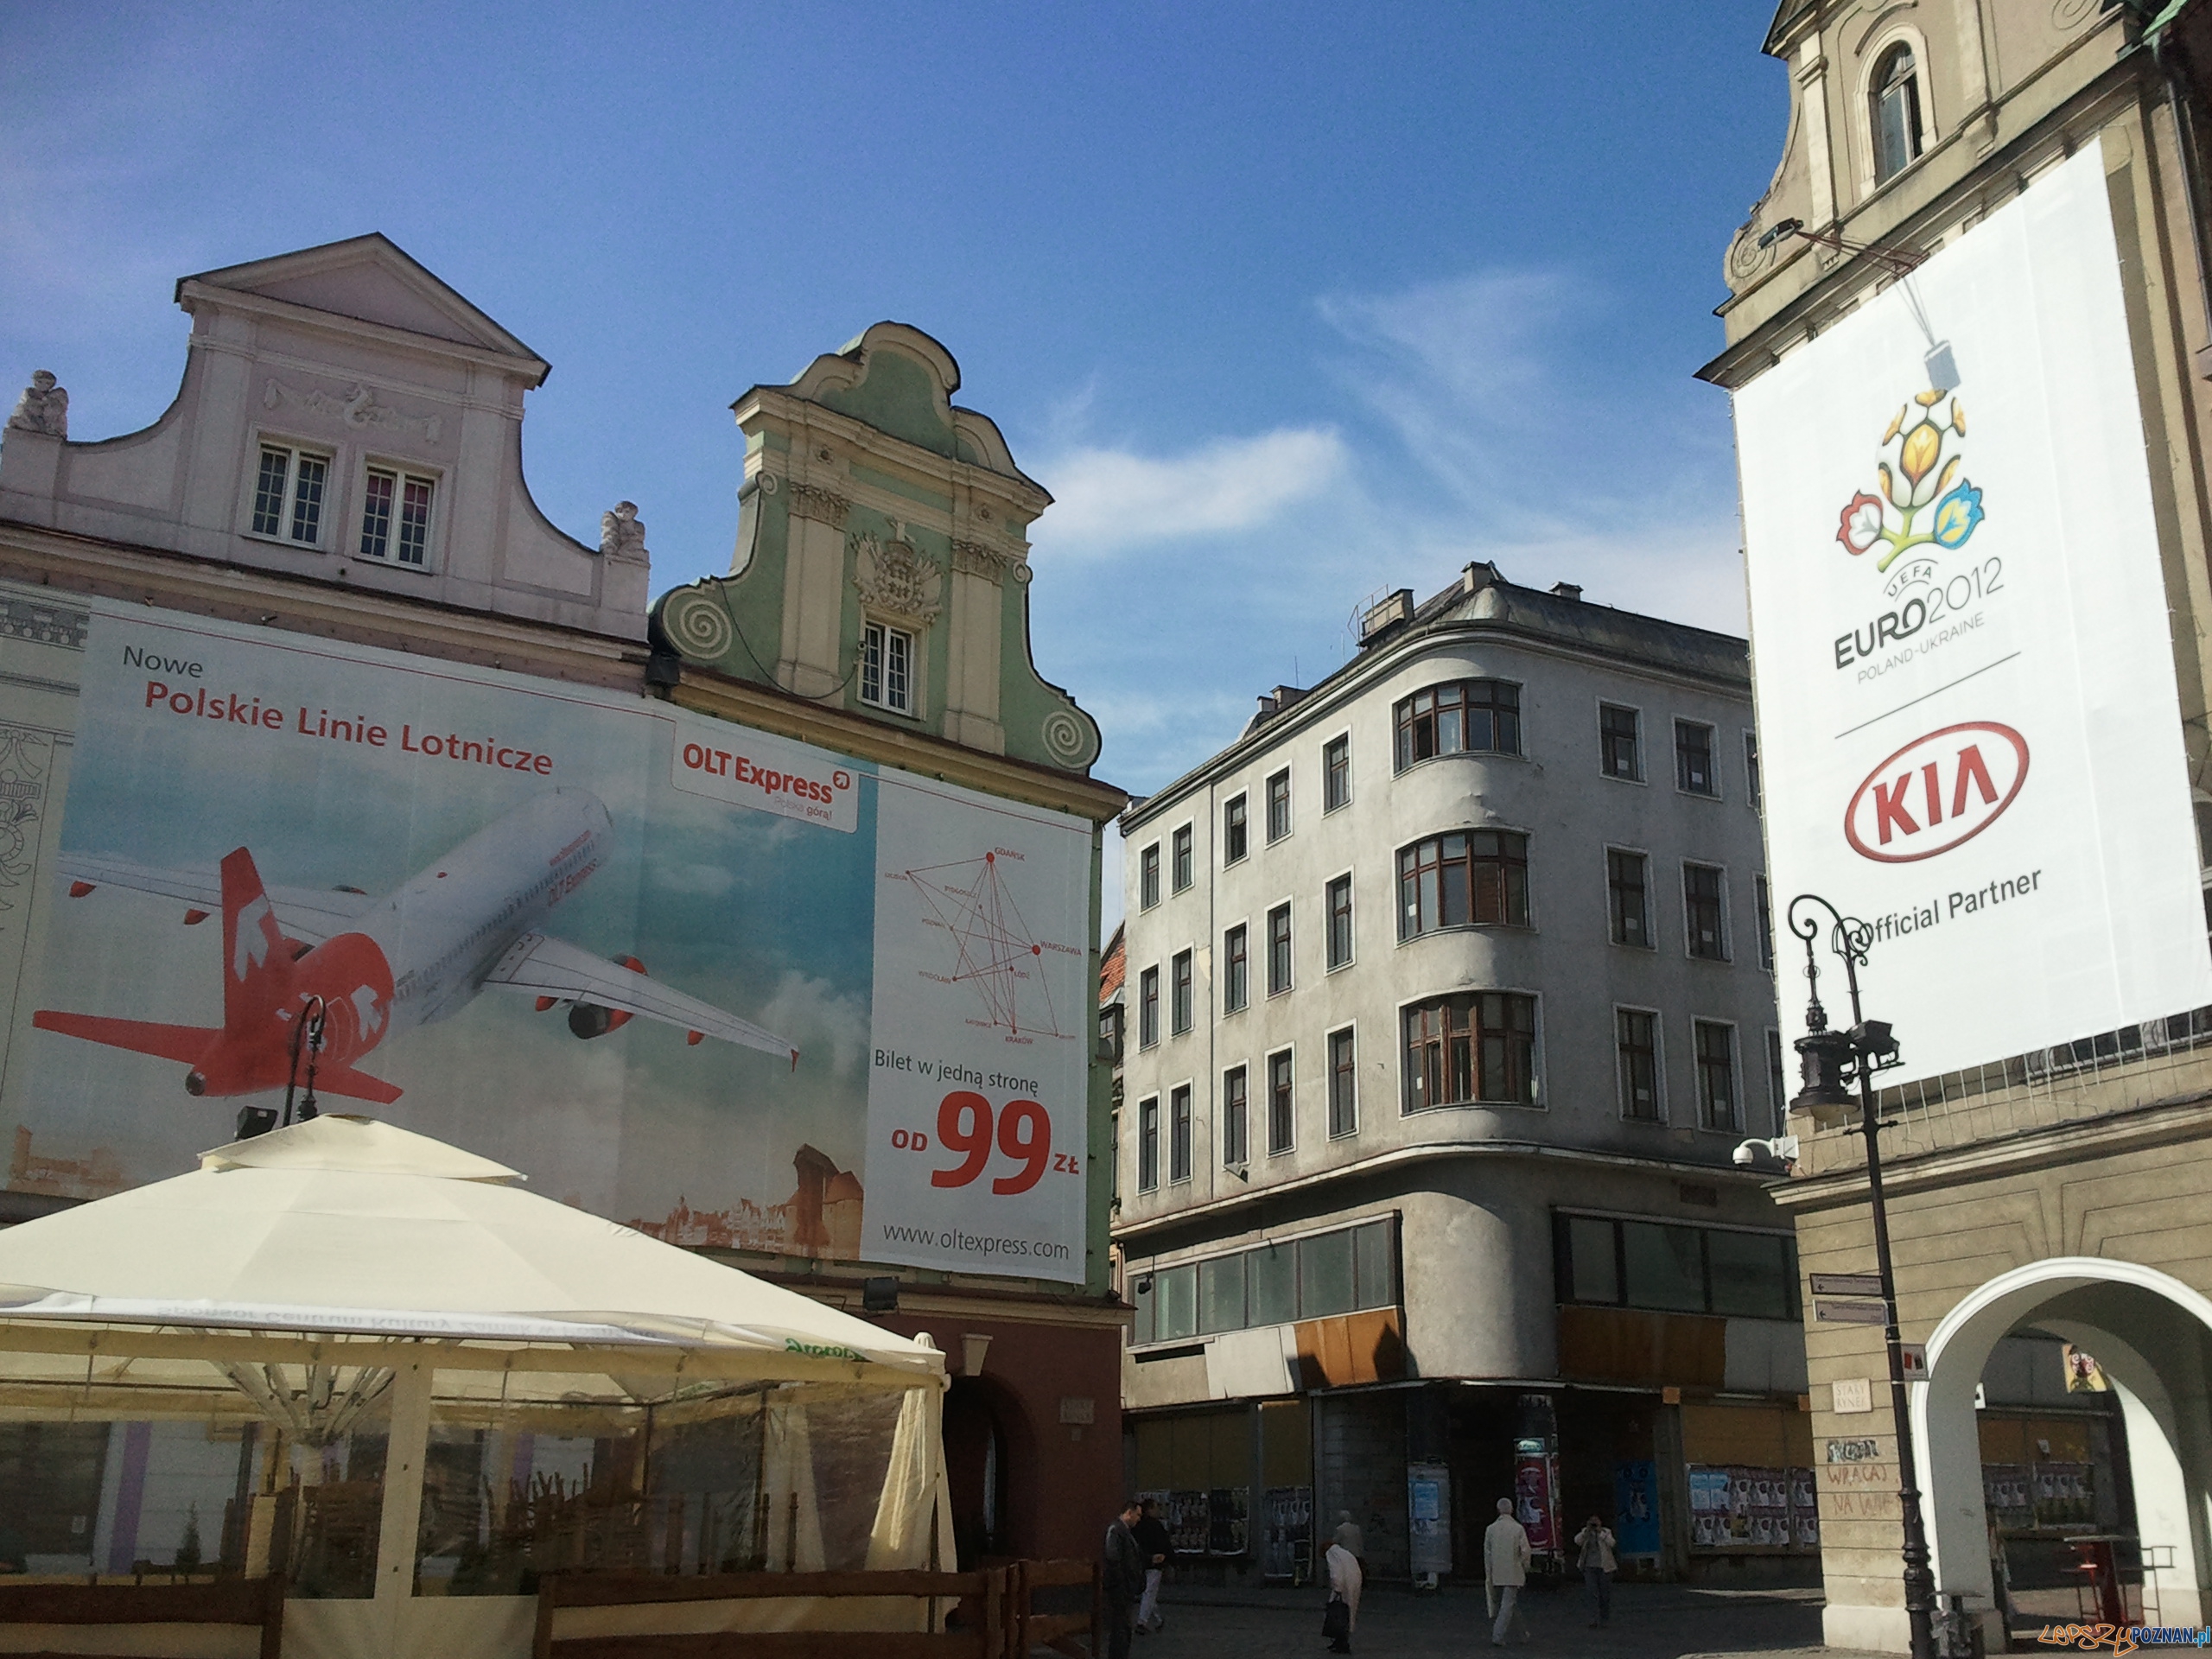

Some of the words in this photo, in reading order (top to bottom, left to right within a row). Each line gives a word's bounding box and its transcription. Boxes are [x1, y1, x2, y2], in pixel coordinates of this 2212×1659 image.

[1887, 565, 1932, 598] UEFA
[124, 645, 204, 678] Nowe
[145, 681, 283, 730] Polskie
[298, 707, 388, 747] Linie
[401, 725, 554, 775] Lotnicze
[683, 743, 733, 776] OLT
[735, 756, 833, 804] Express
[1872, 744, 1999, 846] KIA
[1859, 899, 1940, 948] Official
[1948, 869, 2042, 919] Partner
[874, 1049, 913, 1071] Bilet
[918, 1059, 933, 1076] w
[937, 1059, 983, 1090] jedną
[988, 1072, 1039, 1096] stronę
[892, 1128, 929, 1153] OD
[931, 1090, 1052, 1196] 99
[883, 1224, 1070, 1261] www.oltexpress.com
[1833, 1494, 1853, 1516] NA
